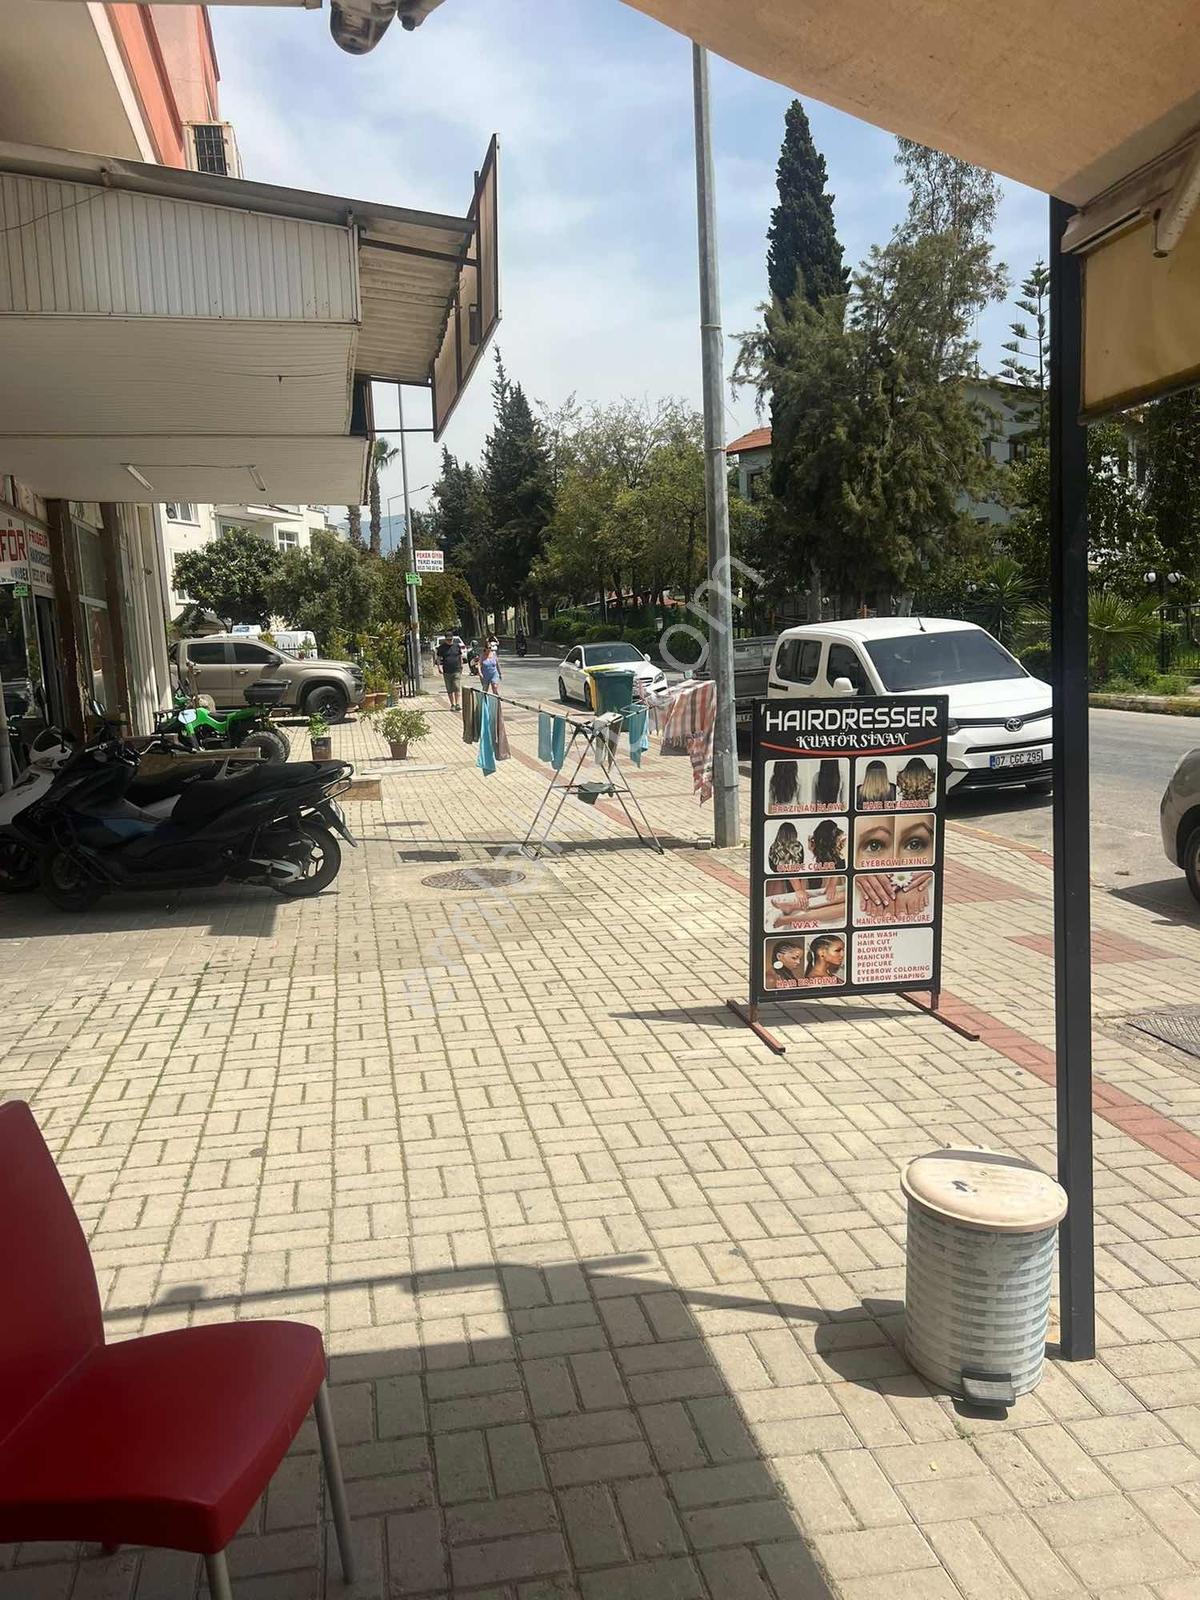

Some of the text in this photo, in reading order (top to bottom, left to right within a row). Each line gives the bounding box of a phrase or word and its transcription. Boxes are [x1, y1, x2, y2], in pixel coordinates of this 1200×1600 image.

[0, 519, 27, 562] FÖR
[765, 706, 938, 732] HAIRDRESSER
[796, 731, 909, 749] KUAFÖR SİNAN
[995, 751, 1041, 766] 07 CGC 295
[771, 803, 815, 813] BRAZILIAN
[777, 861, 836, 872] OMBRE COLOR
[861, 857, 928, 867] EYEBROW FIXING
[791, 920, 820, 929] WAX
[856, 917, 890, 925] MANICURE
[897, 914, 931, 923] PEDICURE
[857, 953, 894, 961] MANICURE
[857, 960, 893, 968] PEDICURE
[857, 965, 930, 975] EYEBROW COLORING
[776, 976, 838, 988] HAIR BRAIDING
[857, 972, 926, 982] EYEBROW SHAPING
